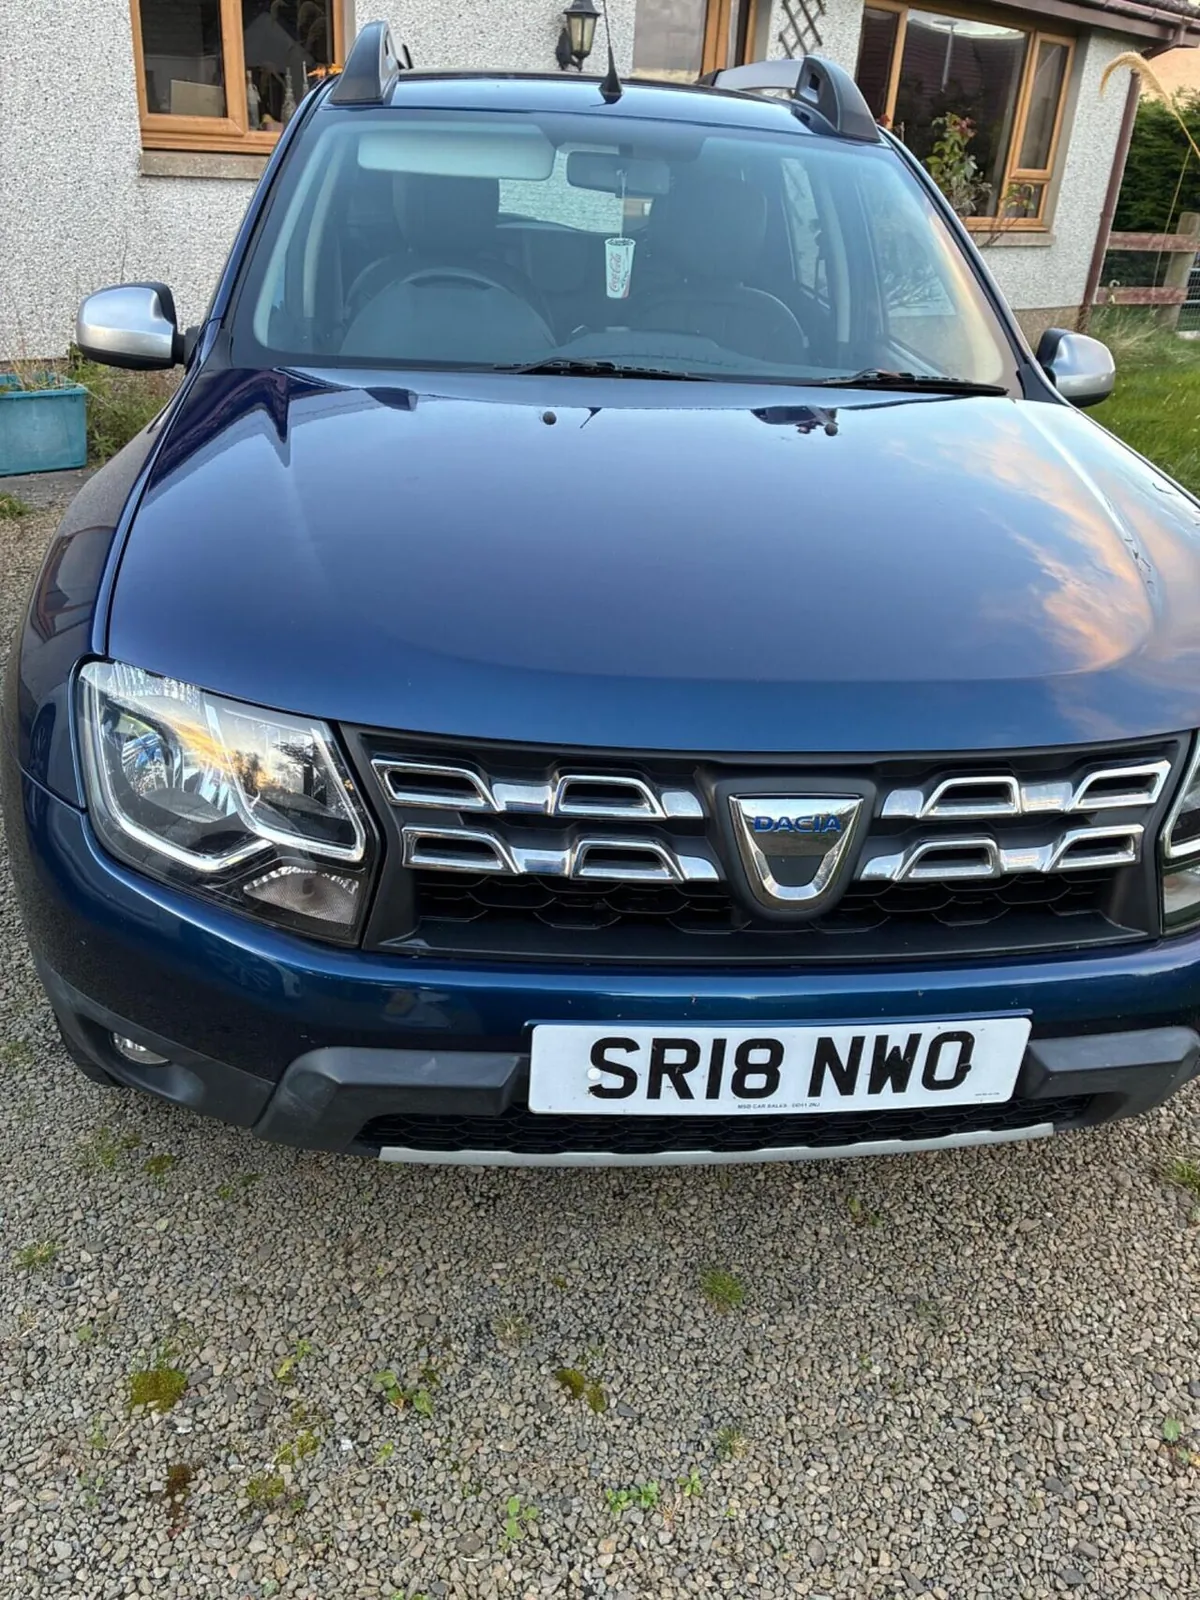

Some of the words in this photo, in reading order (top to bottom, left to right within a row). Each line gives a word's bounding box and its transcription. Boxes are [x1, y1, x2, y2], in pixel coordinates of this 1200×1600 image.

[753, 815, 842, 832] DACIA
[588, 1036, 784, 1100] SR18
[807, 1030, 975, 1098] NWO
